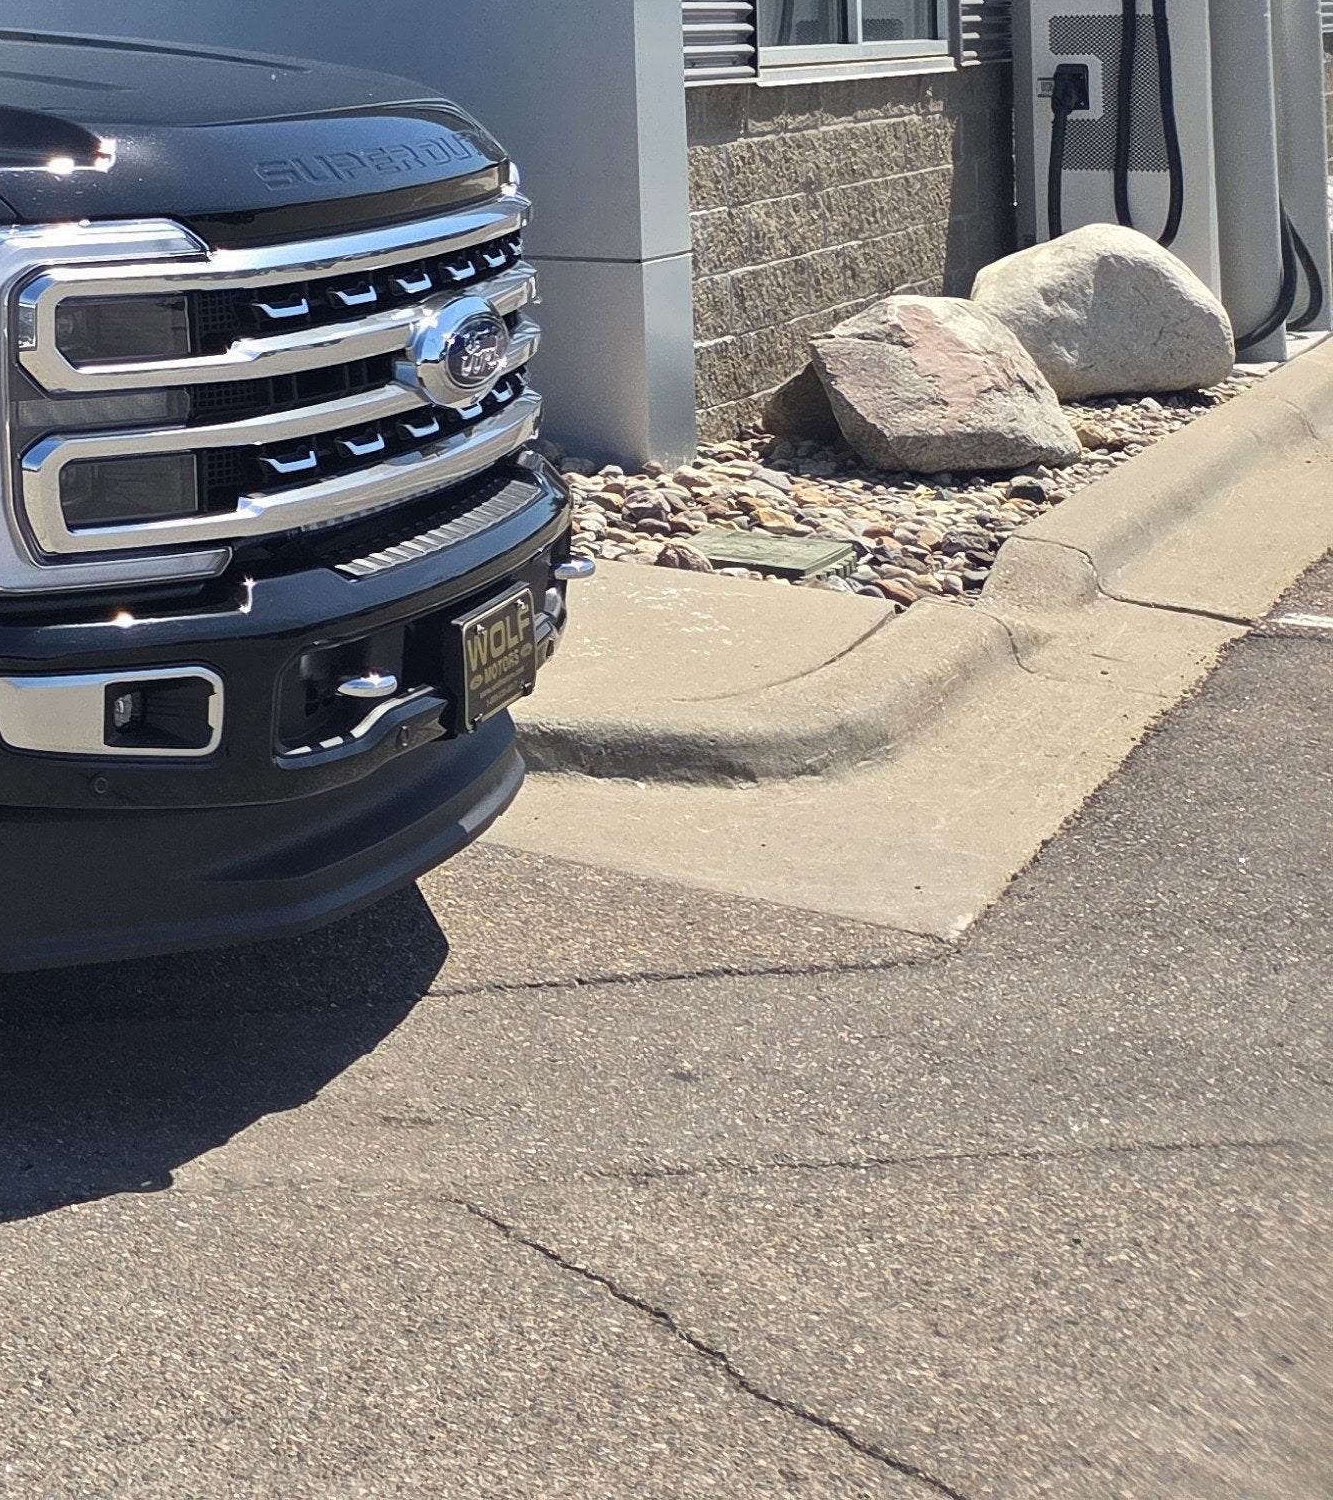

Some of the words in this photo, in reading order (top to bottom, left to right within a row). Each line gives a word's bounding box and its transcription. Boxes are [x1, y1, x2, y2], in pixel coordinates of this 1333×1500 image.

[252, 145, 427, 192] SUPER
[467, 604, 530, 672] WOLF
[484, 648, 520, 686] MOTORS
